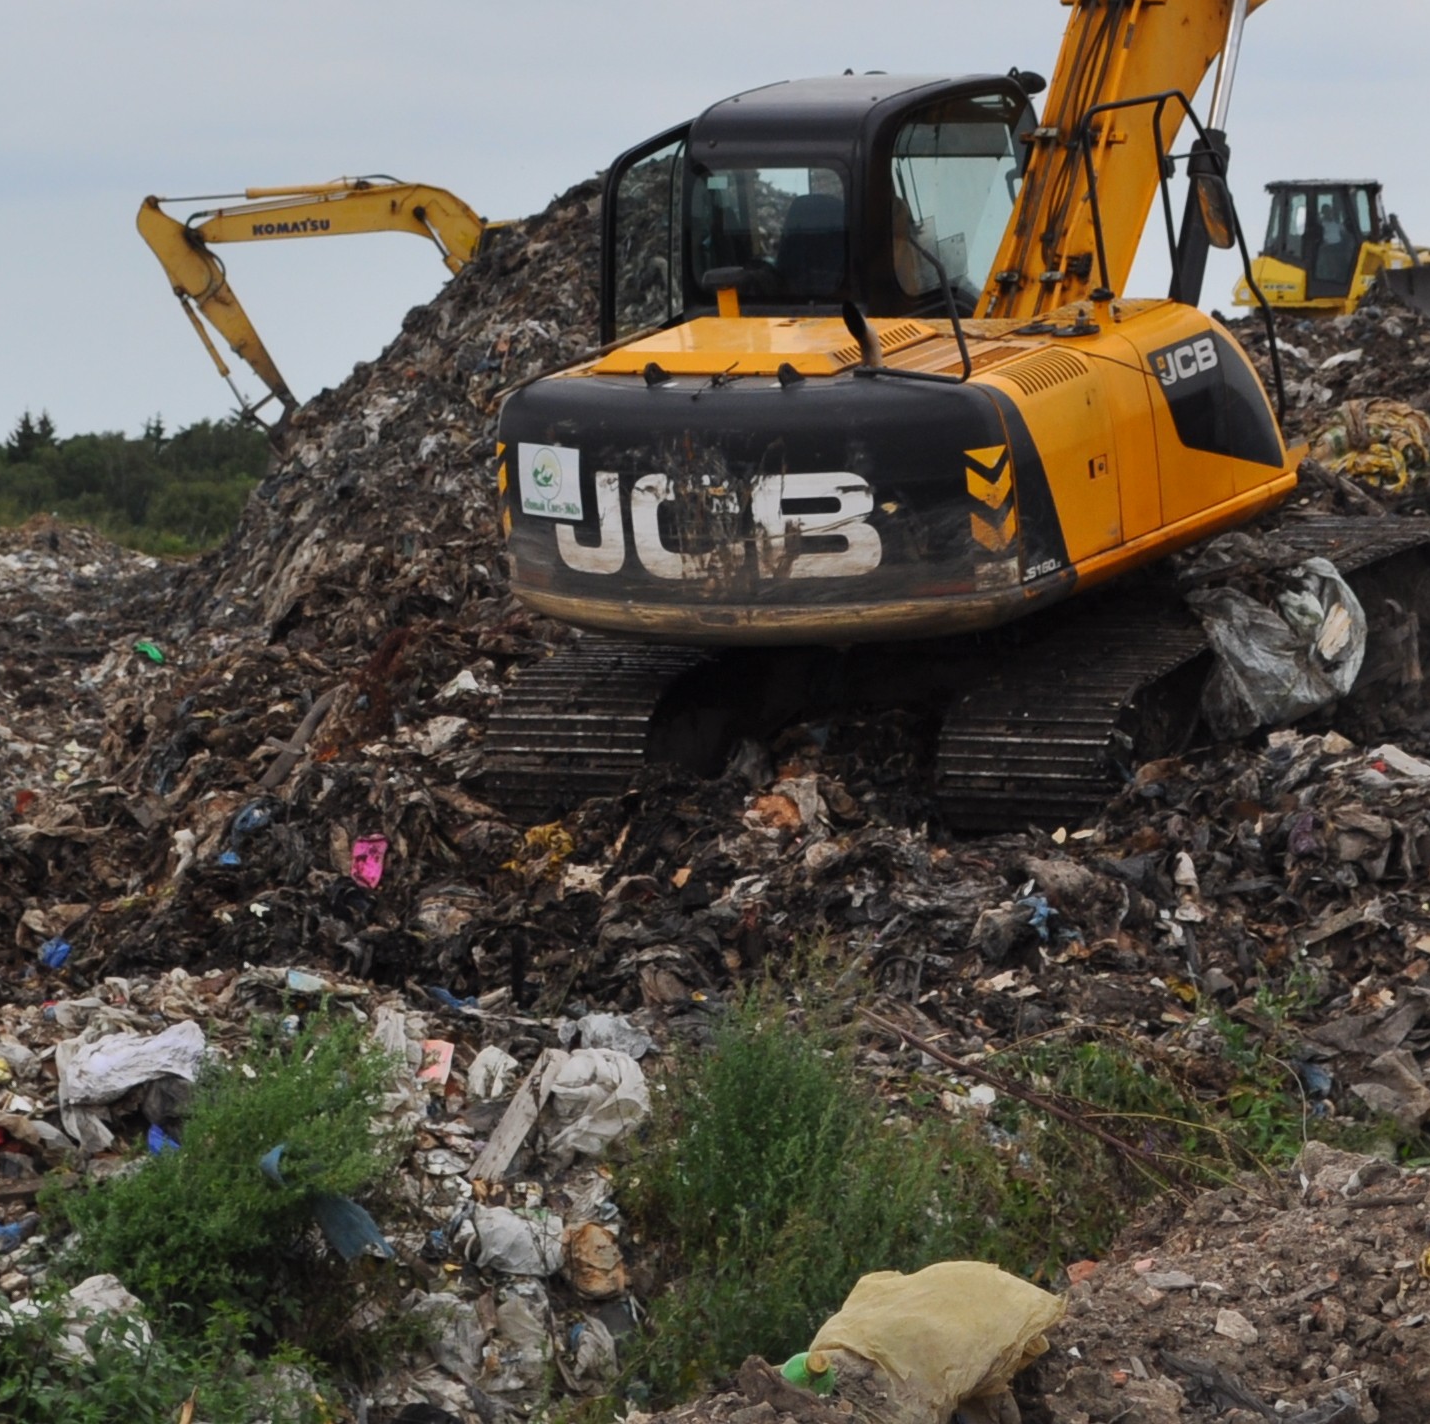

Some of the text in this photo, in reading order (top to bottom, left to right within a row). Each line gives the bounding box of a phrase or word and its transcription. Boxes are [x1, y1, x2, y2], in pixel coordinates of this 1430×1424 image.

[252, 218, 330, 236] KOMATSU
[1160, 337, 1218, 386] JCB
[555, 471, 883, 579] JCB
